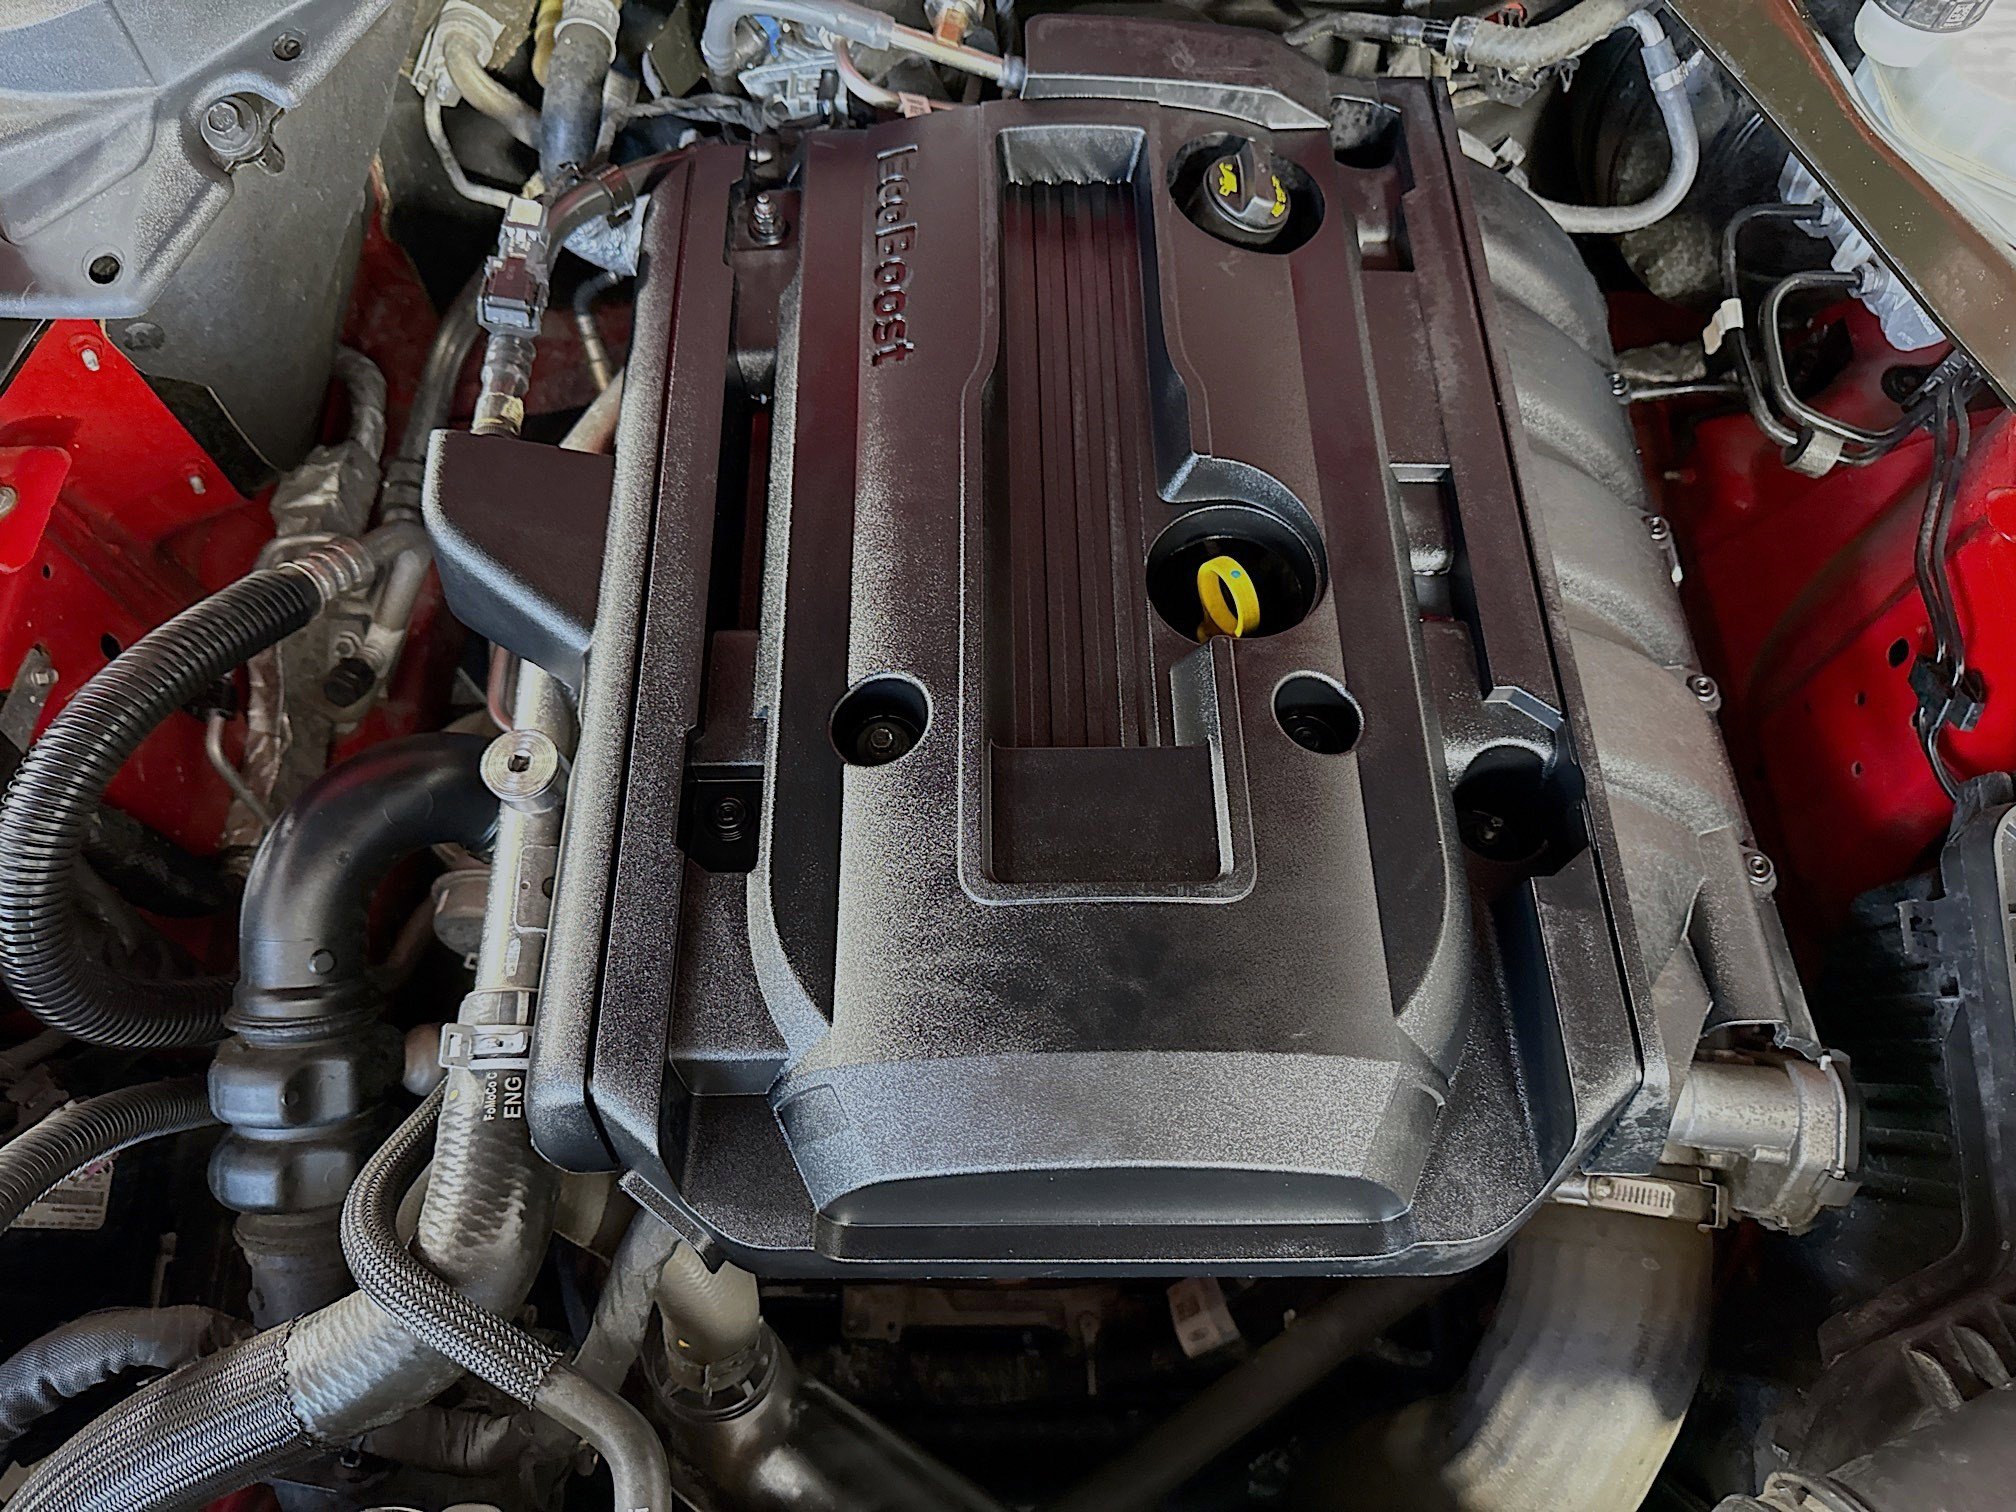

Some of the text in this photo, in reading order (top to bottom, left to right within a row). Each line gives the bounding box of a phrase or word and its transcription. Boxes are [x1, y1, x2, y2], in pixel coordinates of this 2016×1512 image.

[872, 144, 919, 367] EcoBoost
[482, 1081, 498, 1121] FoMoCo
[503, 1076, 522, 1119] ENG
